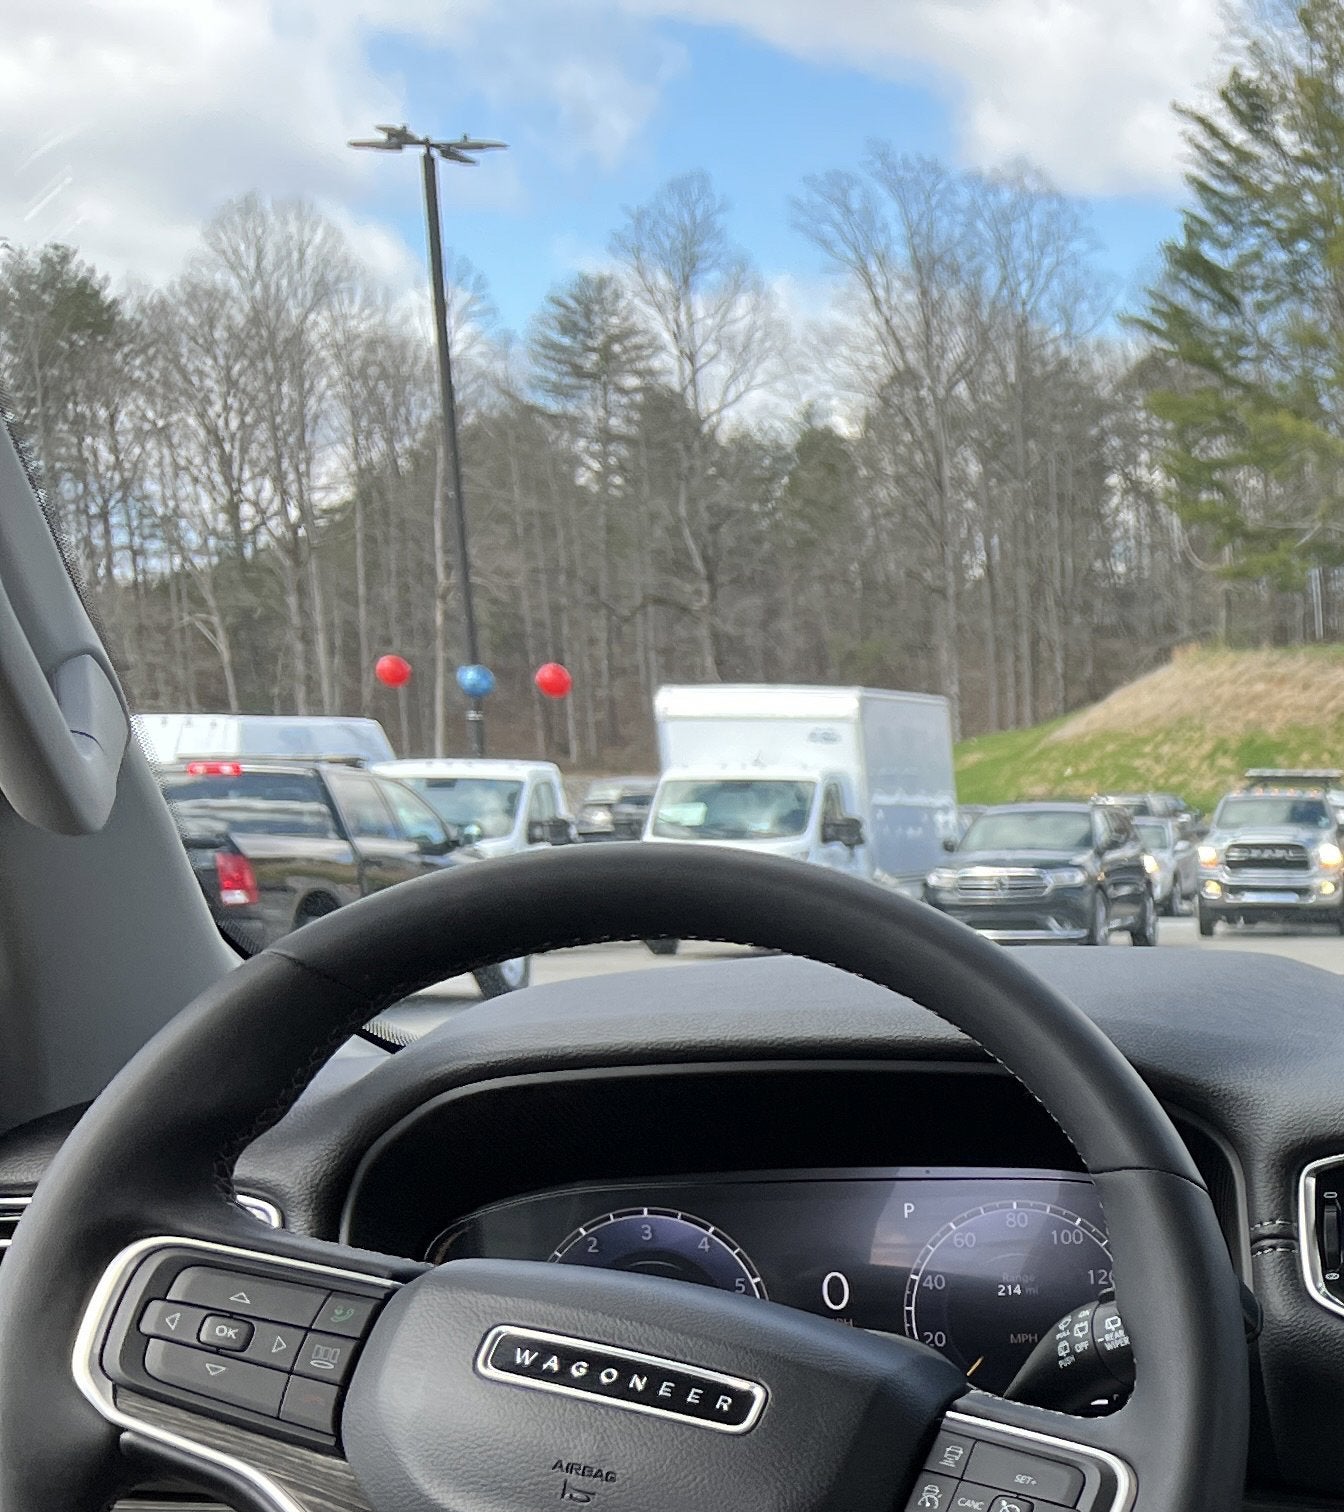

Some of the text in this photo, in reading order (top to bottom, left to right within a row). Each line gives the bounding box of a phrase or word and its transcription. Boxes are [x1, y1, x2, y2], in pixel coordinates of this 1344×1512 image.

[903, 1202, 915, 1219] P
[1005, 1212, 1029, 1228] 80
[640, 1224, 653, 1241] 3
[953, 1232, 976, 1249] 60
[1051, 1229, 1084, 1246] 100
[587, 1237, 600, 1253] 2
[697, 1236, 711, 1252] 4
[734, 1277, 747, 1294] 5
[922, 1274, 946, 1291] 40
[1001, 1271, 1036, 1284] Range
[821, 1271, 850, 1311] 0
[997, 1284, 1039, 1297] 214 mi
[215, 1325, 239, 1340] OK
[923, 1331, 946, 1348] 20
[1010, 1333, 1038, 1345] MPH
[515, 1347, 733, 1412] WAGONEER
[551, 1459, 618, 1484] AIRBAG
[957, 1497, 985, 1512] CANC
